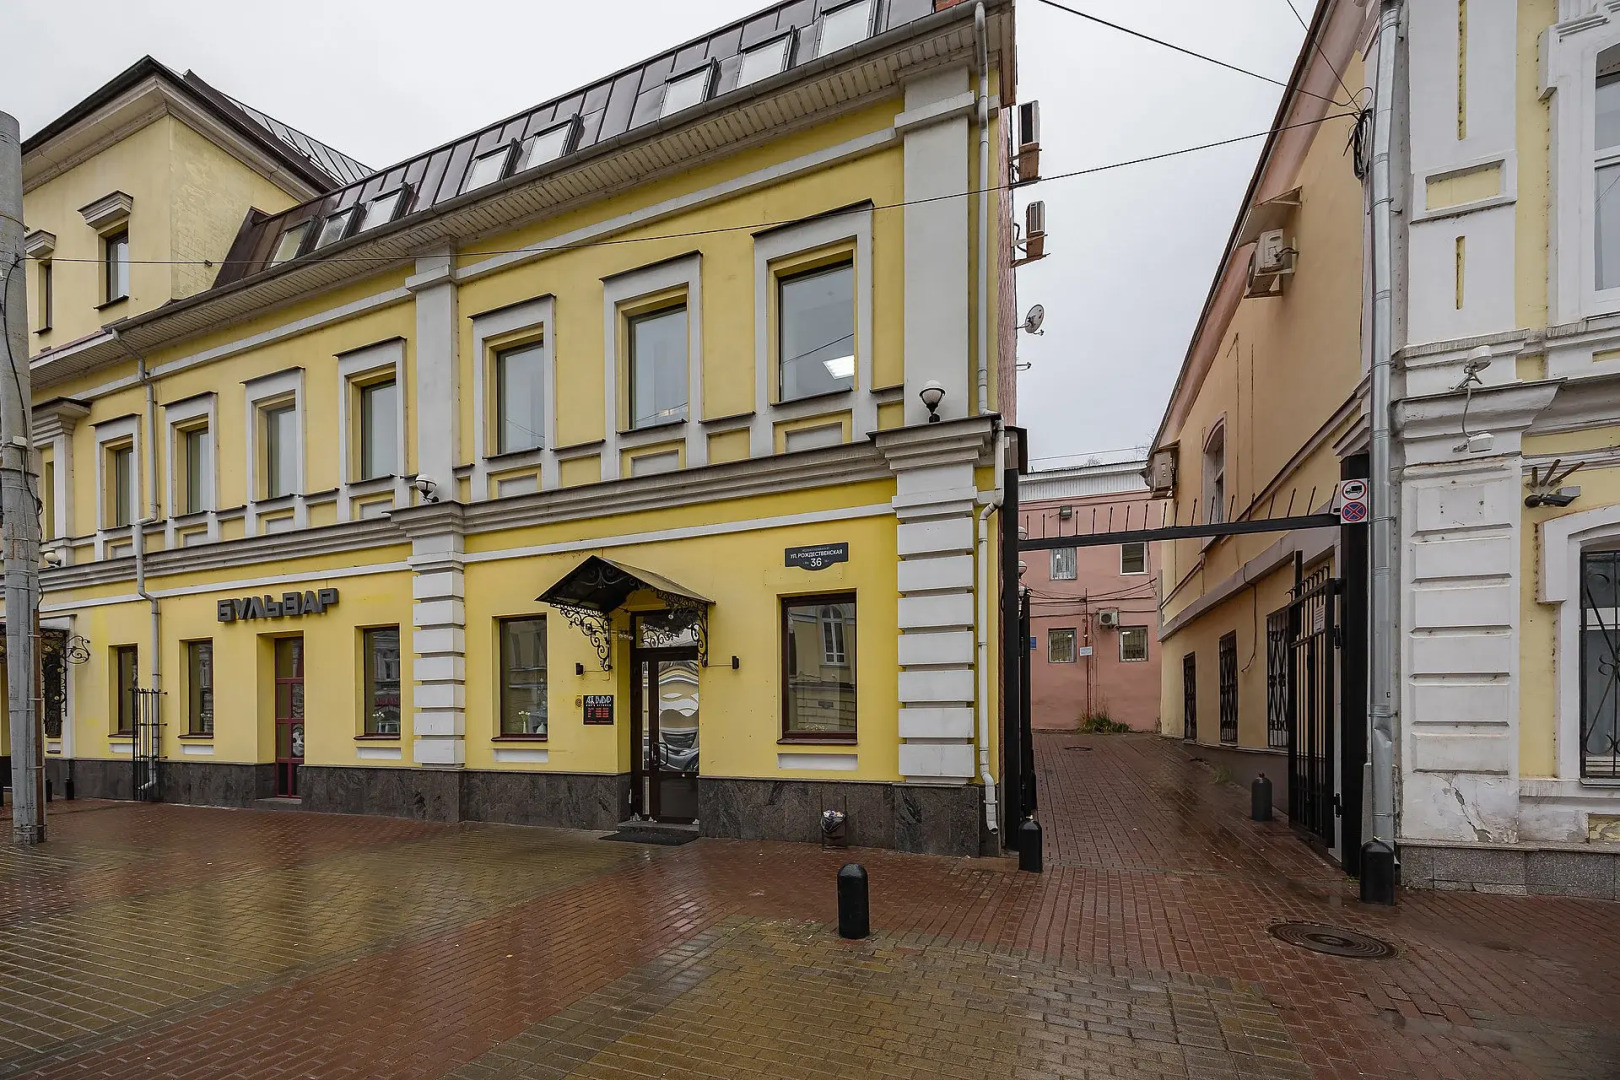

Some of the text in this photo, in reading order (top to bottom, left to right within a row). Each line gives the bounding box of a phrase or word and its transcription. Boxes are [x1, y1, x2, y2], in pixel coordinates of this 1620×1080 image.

[797, 549, 843, 558] РОЖДЕСТВЕНСКАЯ
[810, 557, 822, 567] 36
[217, 588, 339, 622] БУЛЬВАР
